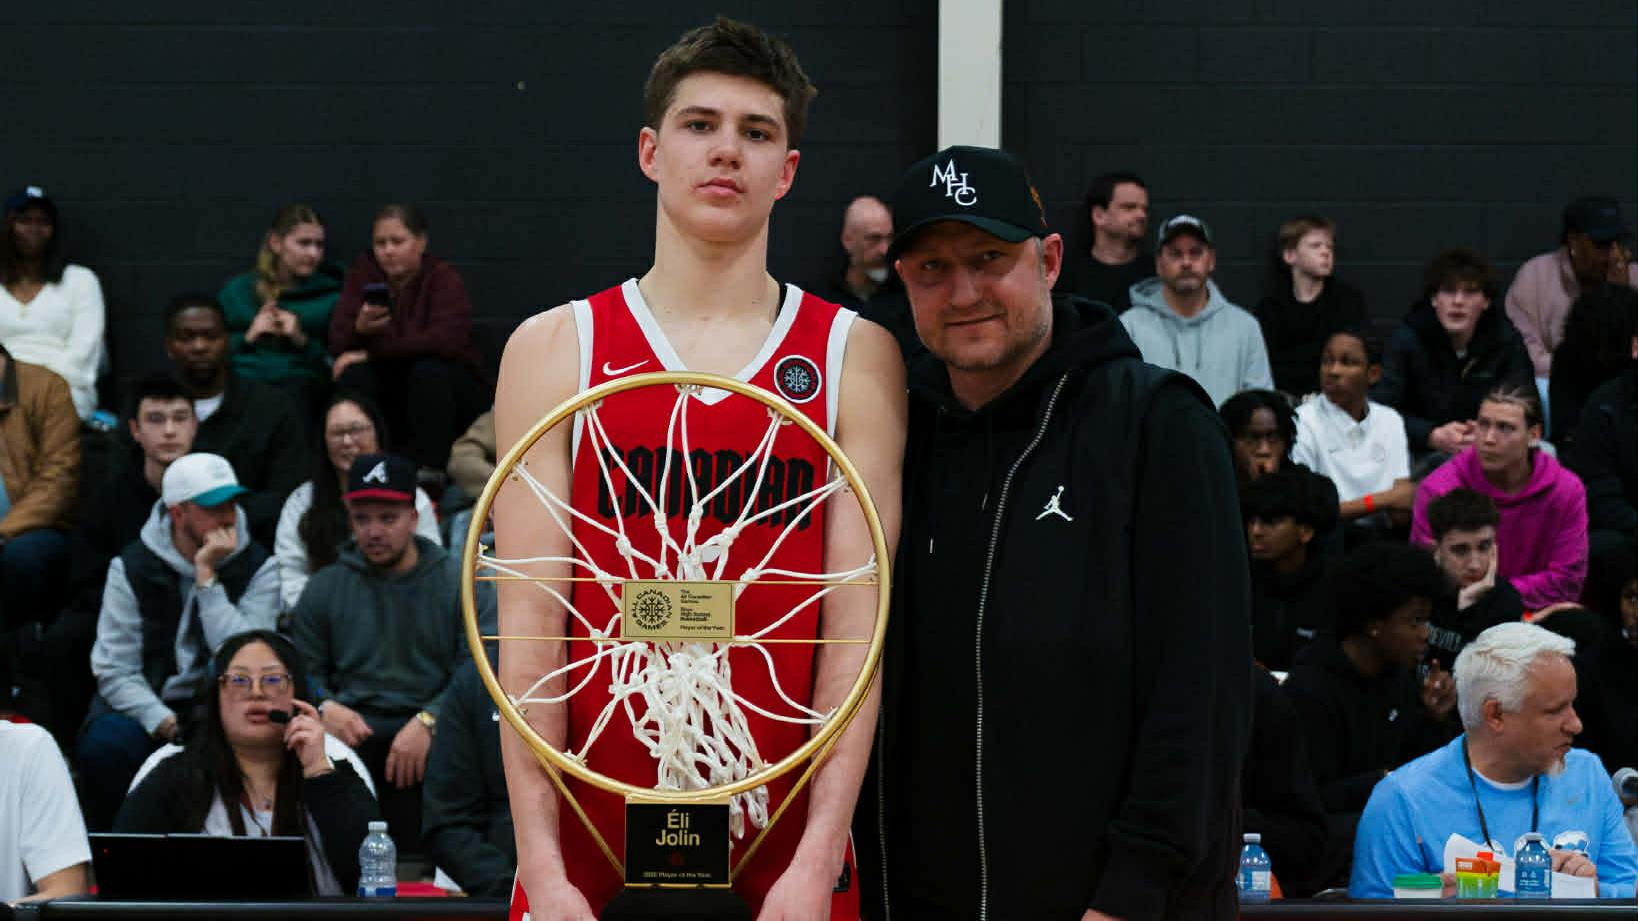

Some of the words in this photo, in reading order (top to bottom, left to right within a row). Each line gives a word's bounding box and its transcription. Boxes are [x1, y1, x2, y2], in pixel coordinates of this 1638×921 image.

[929, 158, 977, 206] MHC
[598, 445, 814, 531] CANADIAN
[636, 589, 673, 619] CANADIAN
[635, 619, 668, 631] GAMES
[667, 809, 689, 829] Éli
[655, 829, 700, 846] Jolin
